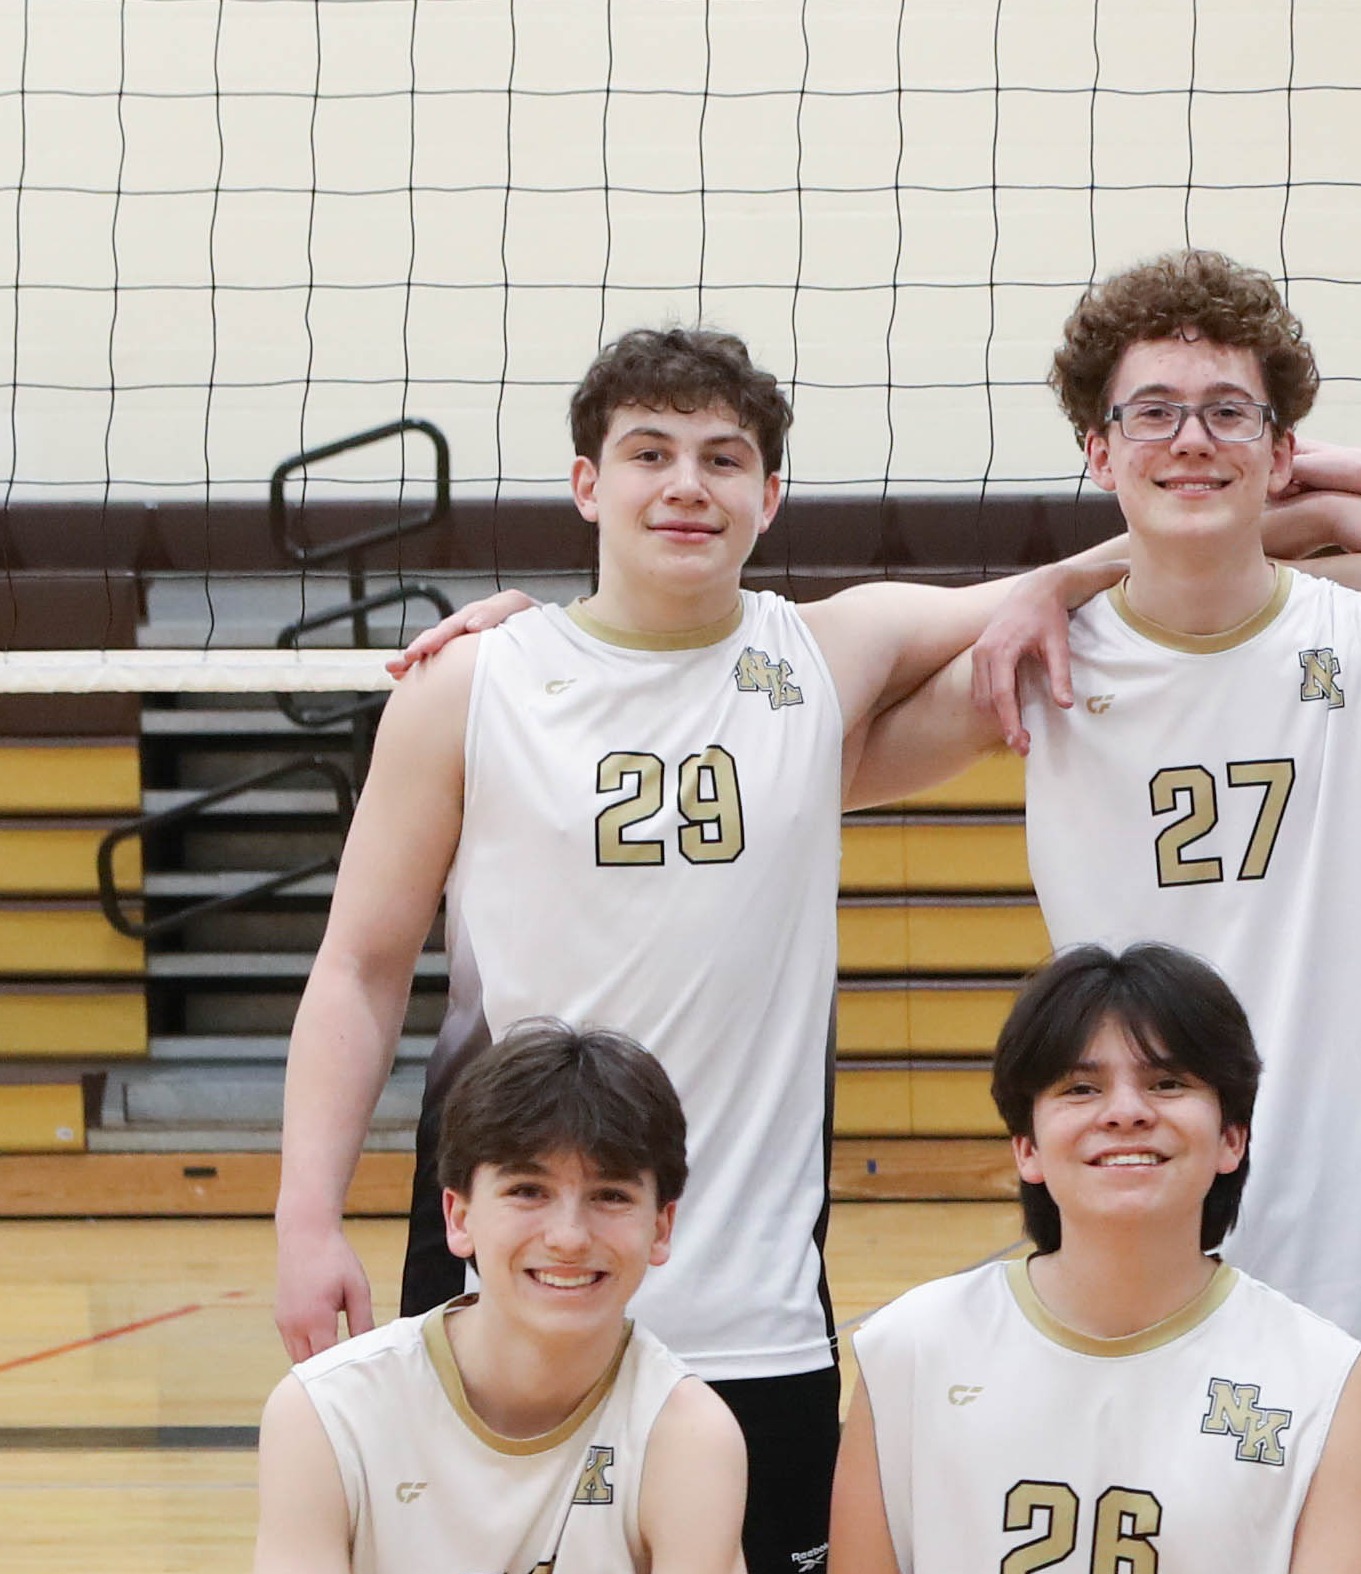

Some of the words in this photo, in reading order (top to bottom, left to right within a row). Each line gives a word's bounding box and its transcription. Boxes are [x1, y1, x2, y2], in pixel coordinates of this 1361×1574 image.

[734, 646, 804, 711] NK
[595, 744, 745, 867] 29
[1149, 758, 1296, 888] 27
[1201, 1377, 1292, 1467] NK
[571, 1445, 614, 1505] K
